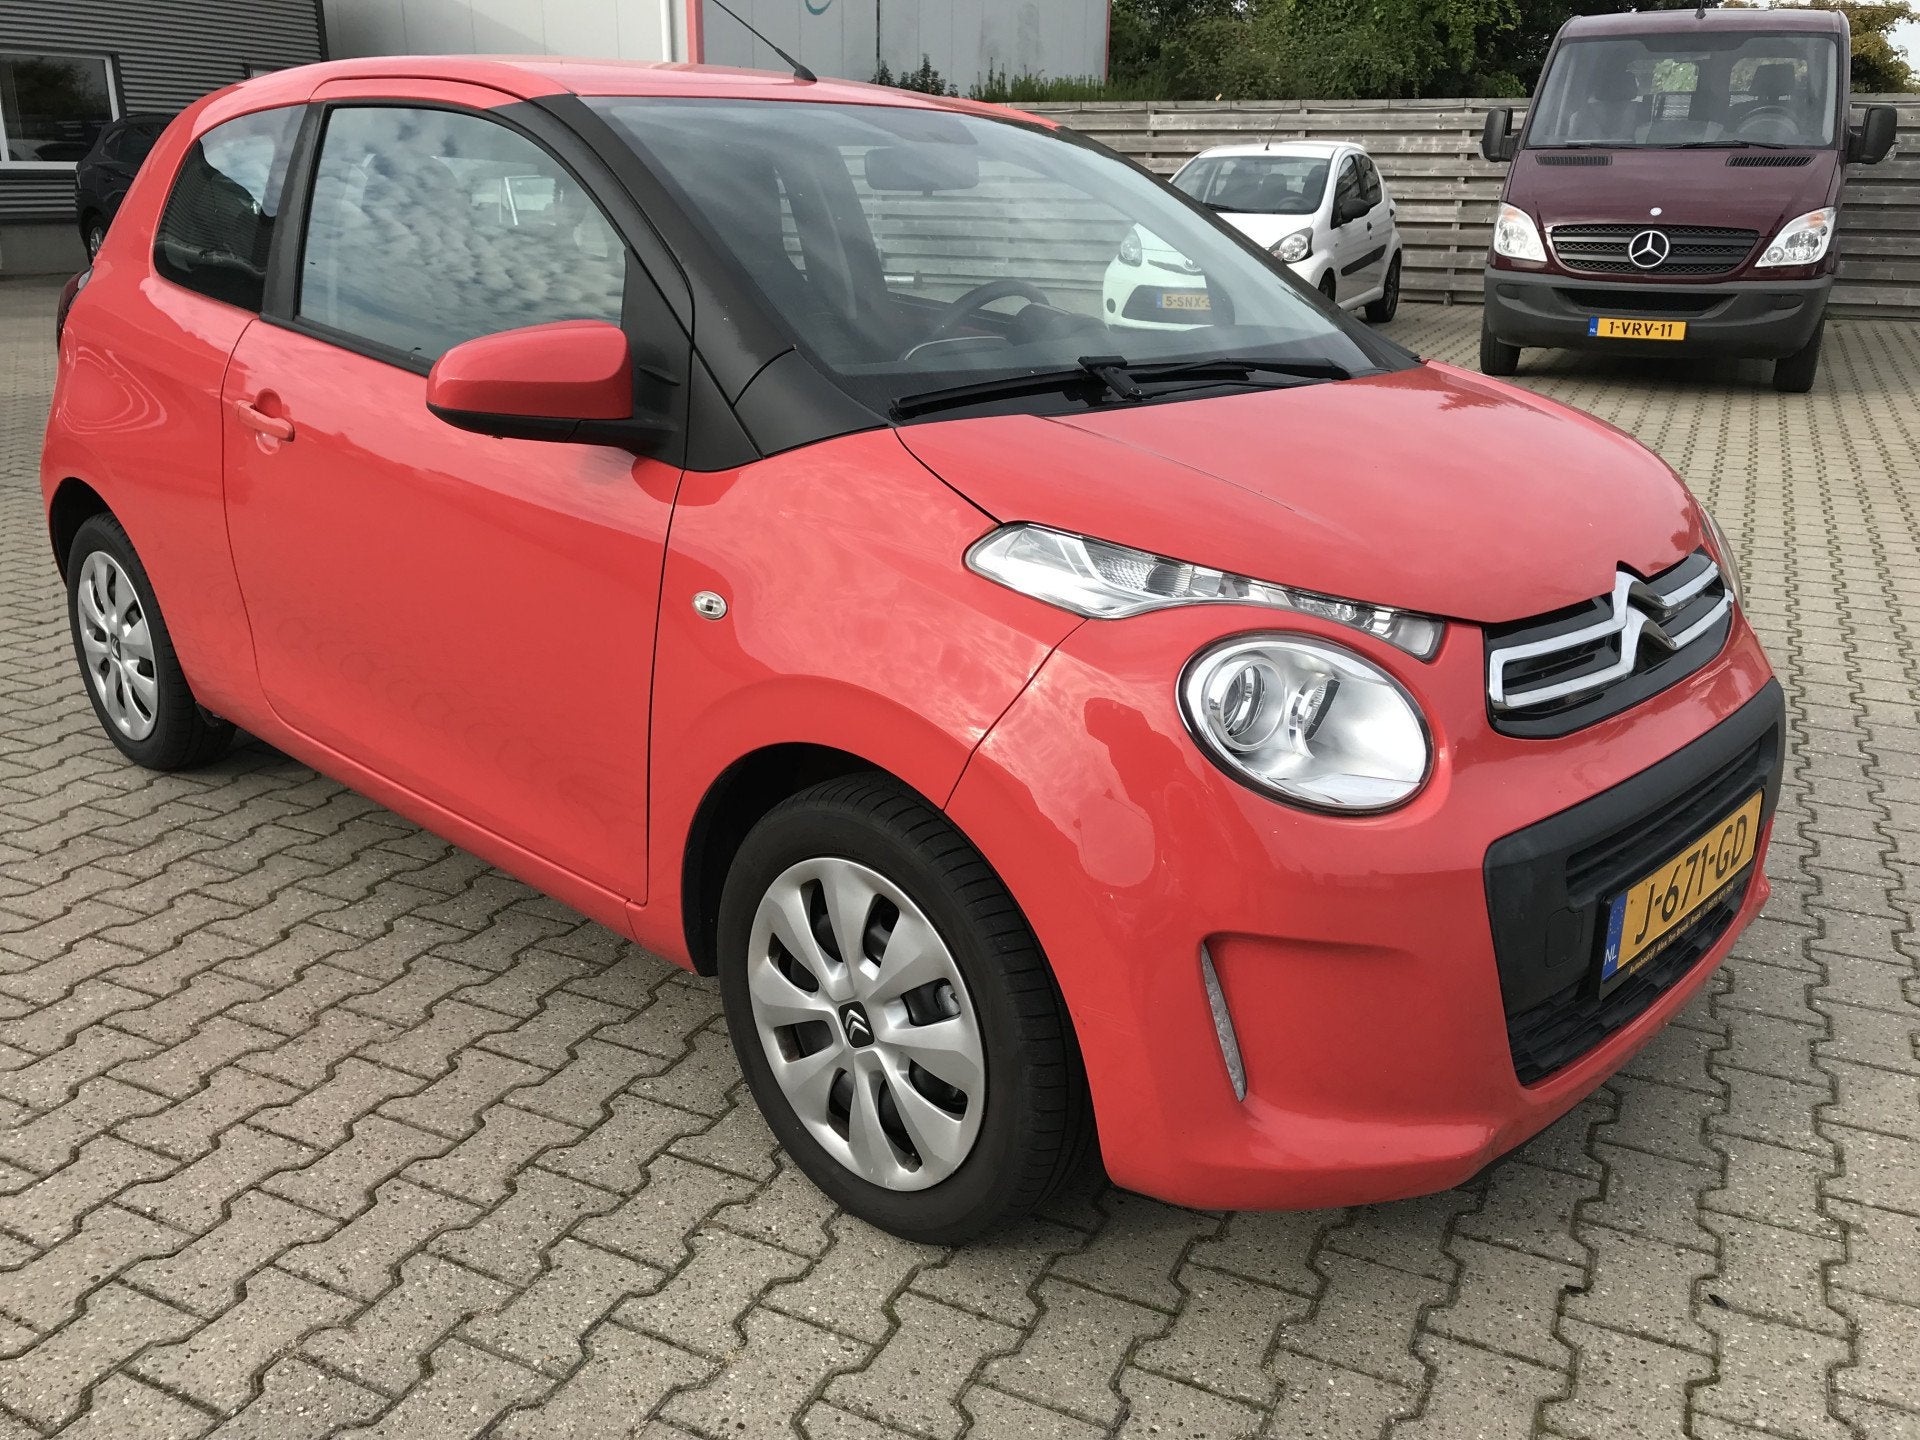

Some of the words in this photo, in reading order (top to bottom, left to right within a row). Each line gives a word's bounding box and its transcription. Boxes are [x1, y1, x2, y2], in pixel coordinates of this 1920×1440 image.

[1609, 321, 1673, 337] 1-VRV-11
[1634, 814, 1748, 945] J-671-GD
[1603, 948, 1617, 966] NL
